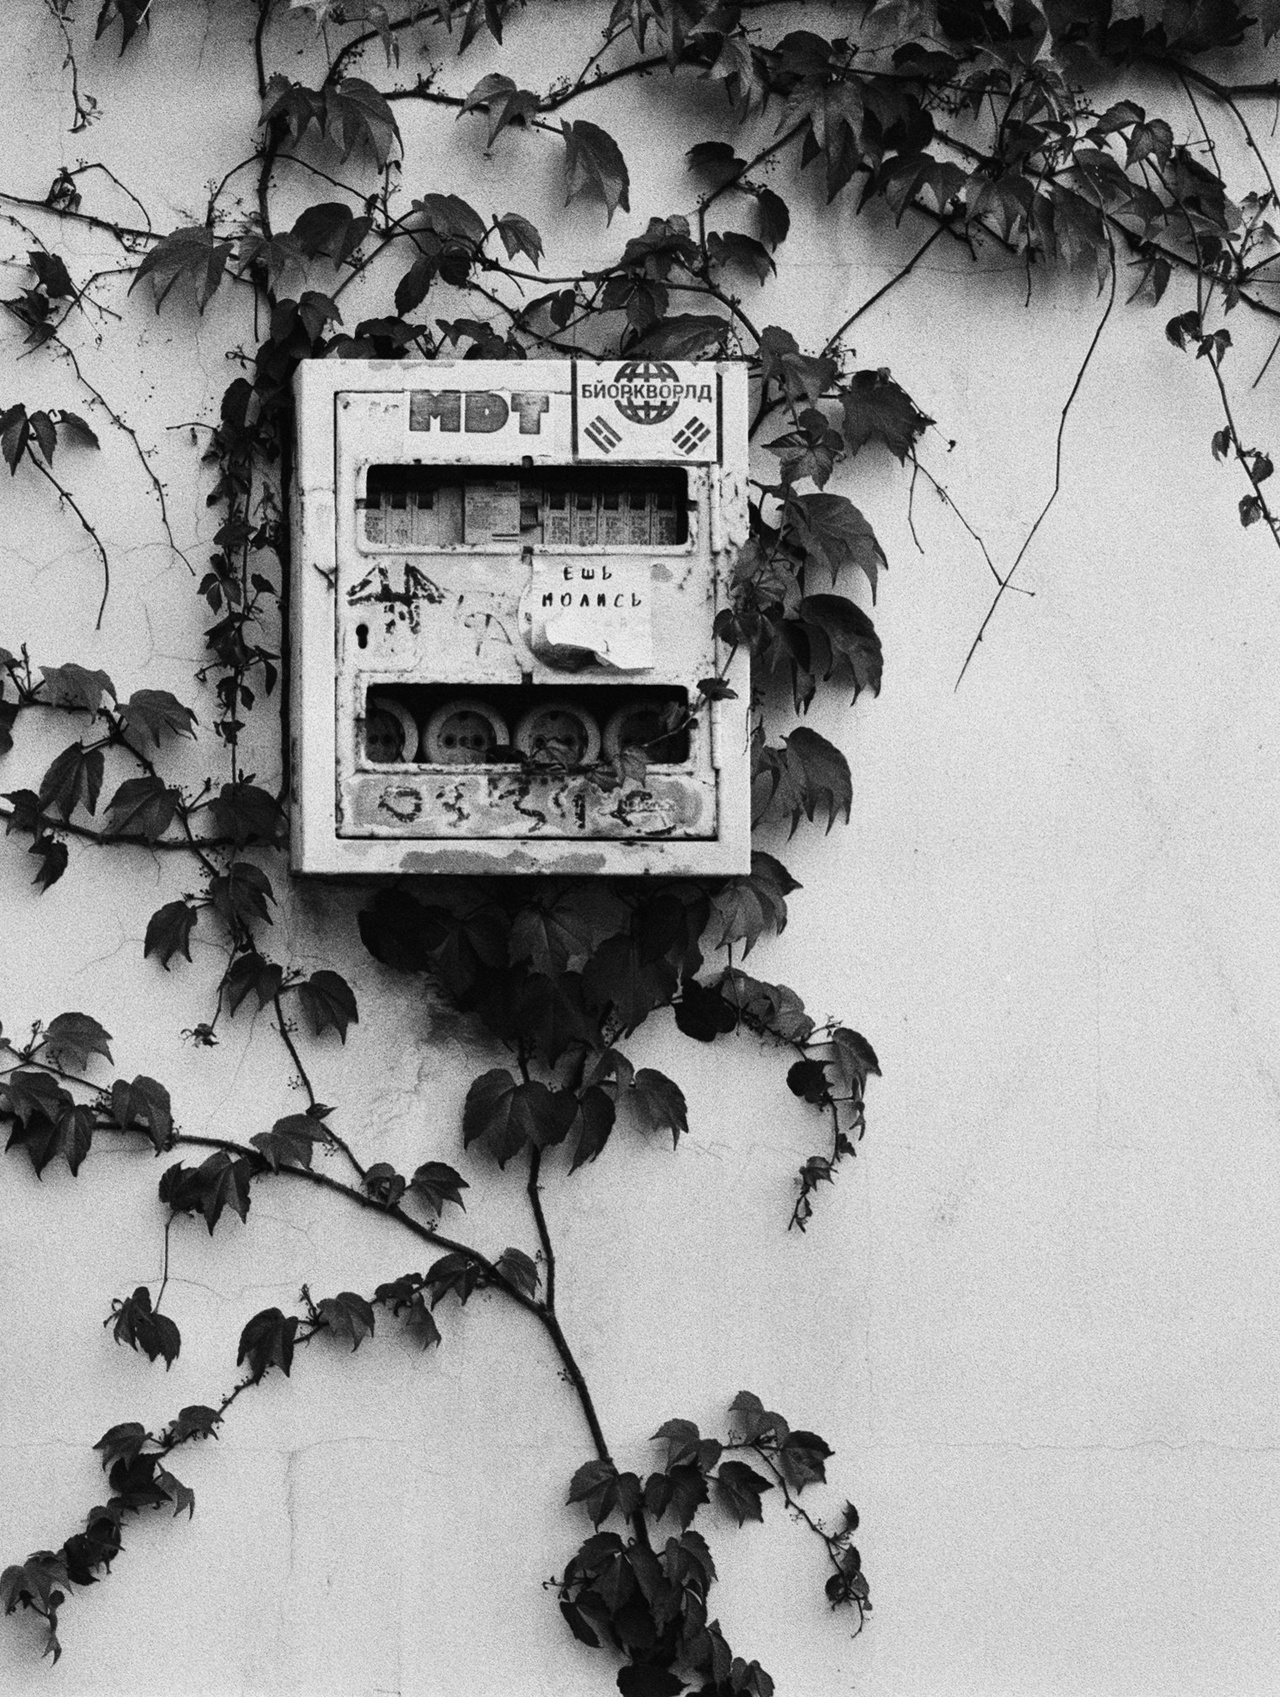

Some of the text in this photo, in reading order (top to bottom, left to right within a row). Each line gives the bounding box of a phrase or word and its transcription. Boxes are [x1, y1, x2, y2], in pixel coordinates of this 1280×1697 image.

[581, 379, 713, 403] БЙОРКВОРЛД
[409, 389, 550, 435] MDT
[563, 565, 612, 581] ЕШЬ
[541, 591, 642, 608] МОЛИСЬ
